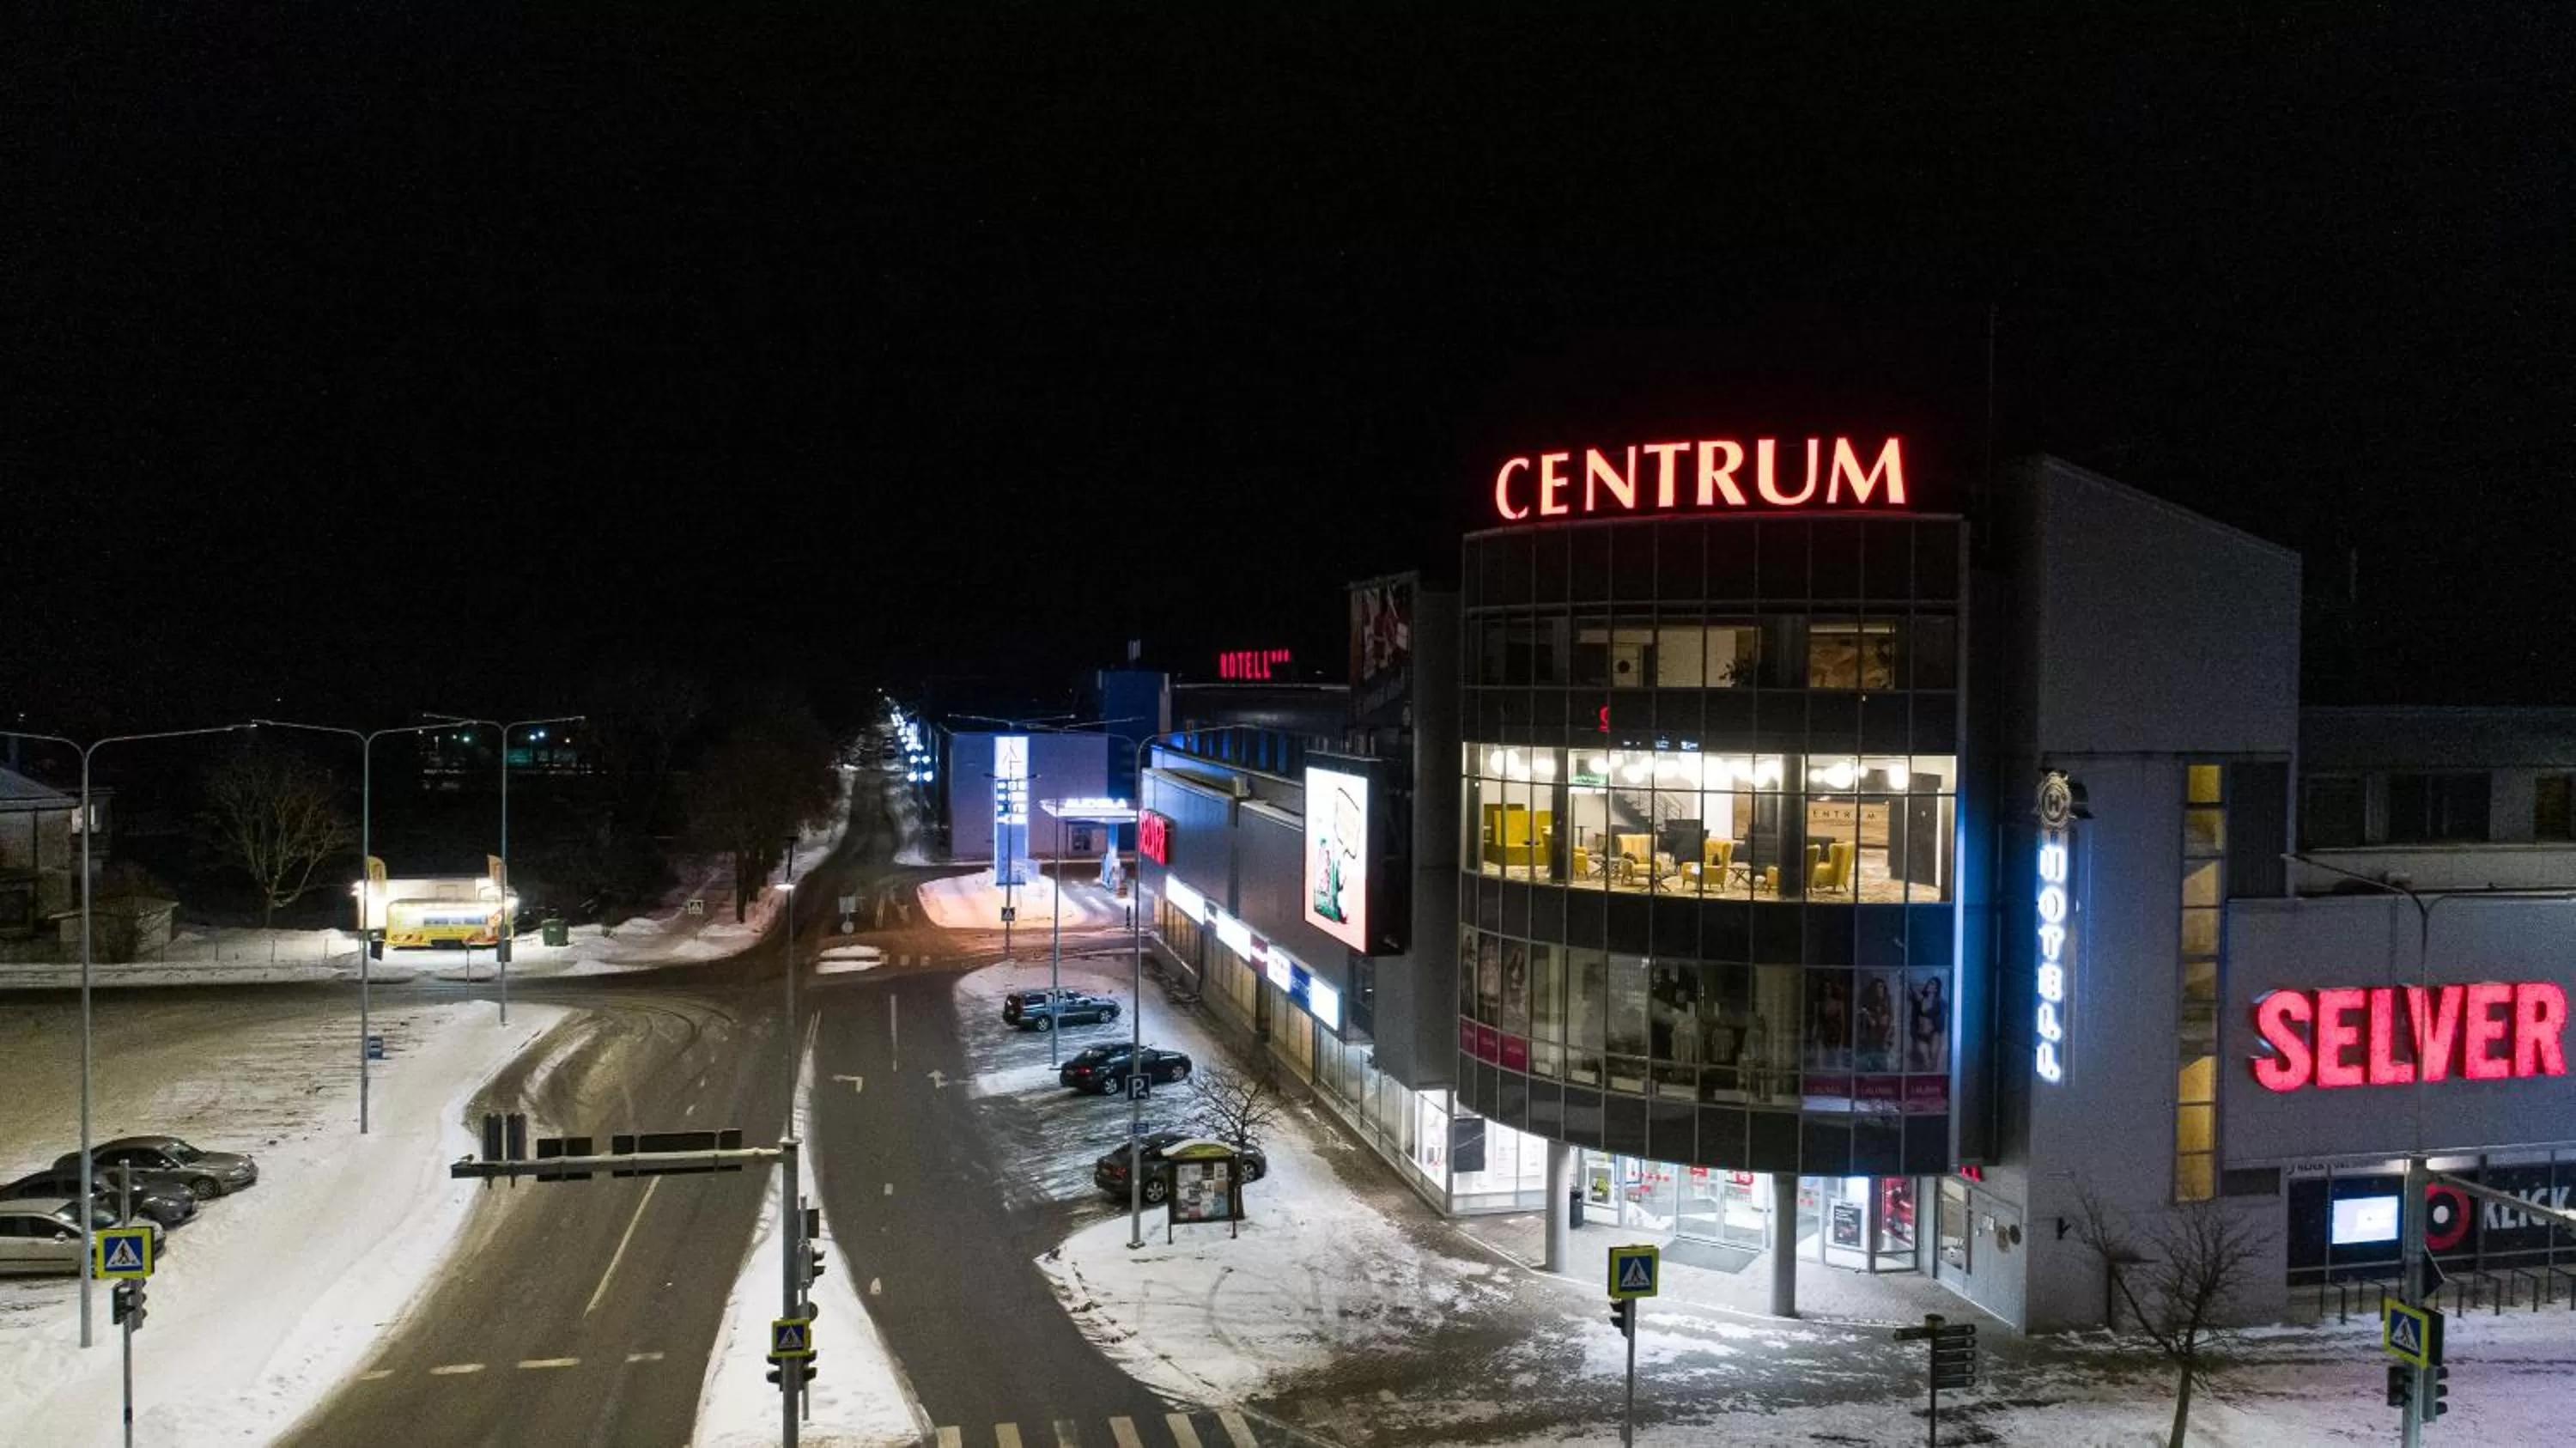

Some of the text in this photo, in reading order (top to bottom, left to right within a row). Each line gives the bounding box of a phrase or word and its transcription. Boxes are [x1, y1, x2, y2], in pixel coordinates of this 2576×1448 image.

[1496, 437, 1906, 520] CENTRUM
[1220, 651, 1271, 679] HOTELL
[2253, 983, 2567, 1092] SELVER
